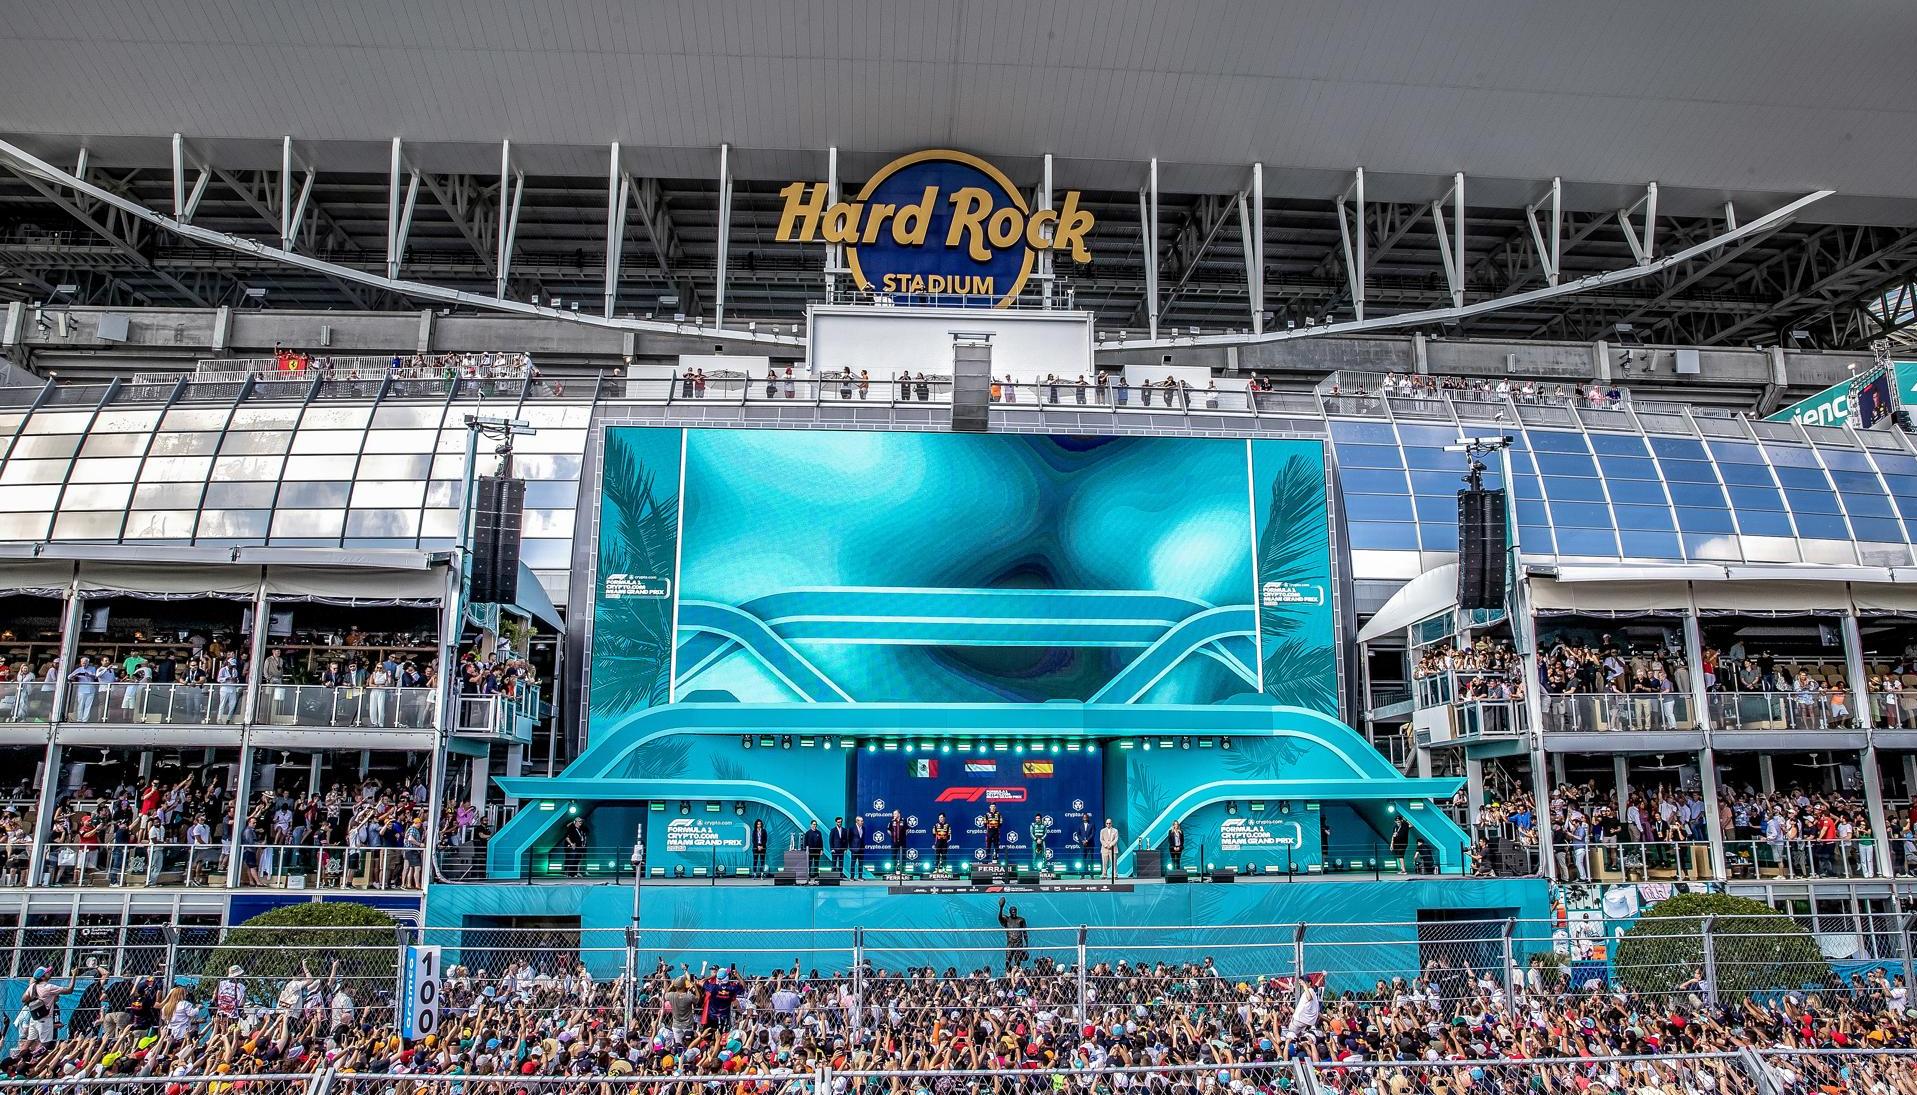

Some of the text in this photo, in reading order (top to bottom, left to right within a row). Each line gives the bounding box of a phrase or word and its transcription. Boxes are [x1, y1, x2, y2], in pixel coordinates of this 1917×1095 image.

[775, 182, 1095, 264] Hard Rock
[883, 273, 994, 295] STADIUM
[418, 951, 436, 1034] 100
